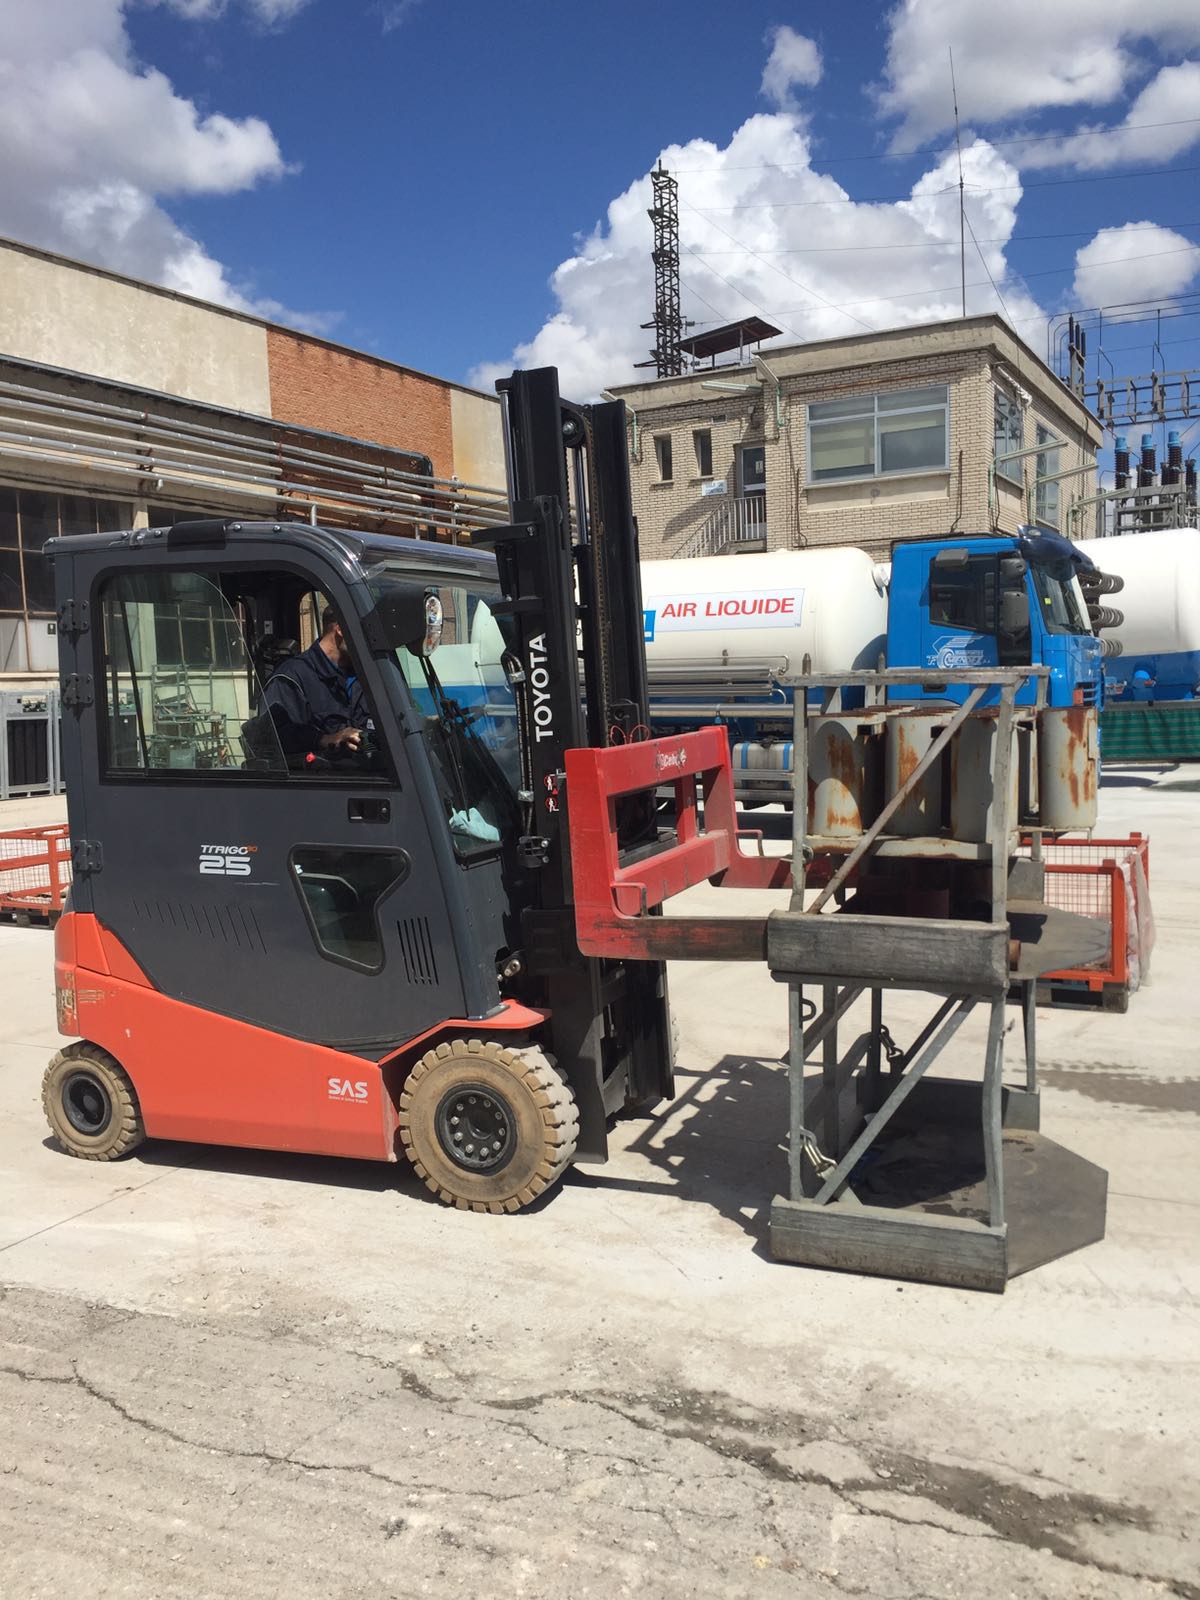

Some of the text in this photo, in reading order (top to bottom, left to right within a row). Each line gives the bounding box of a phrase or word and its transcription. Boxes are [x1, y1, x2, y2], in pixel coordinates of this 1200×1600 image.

[661, 597, 795, 618] AIR LIQUIDE
[529, 633, 553, 742] TOYOTA
[199, 855, 251, 876] 25
[328, 1078, 368, 1099] SAS
